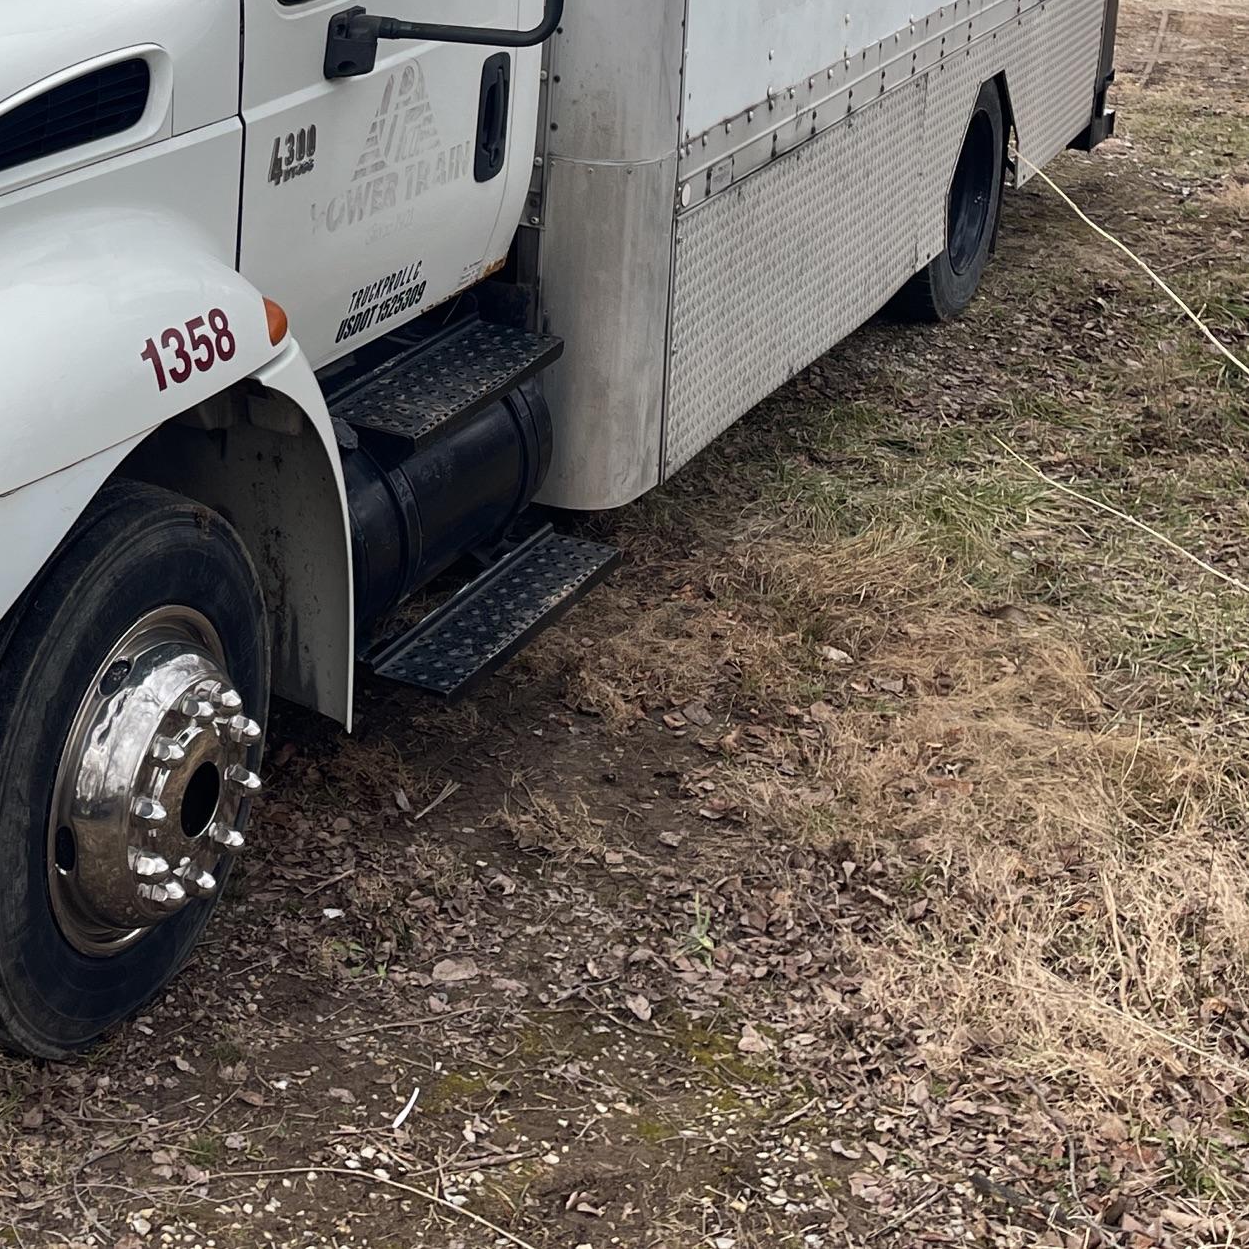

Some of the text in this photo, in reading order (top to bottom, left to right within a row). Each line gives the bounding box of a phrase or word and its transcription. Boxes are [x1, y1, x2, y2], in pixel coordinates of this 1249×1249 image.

[268, 124, 317, 186] 4300
[335, 280, 427, 343] USDOT 1525309
[140, 308, 236, 392] 1358
